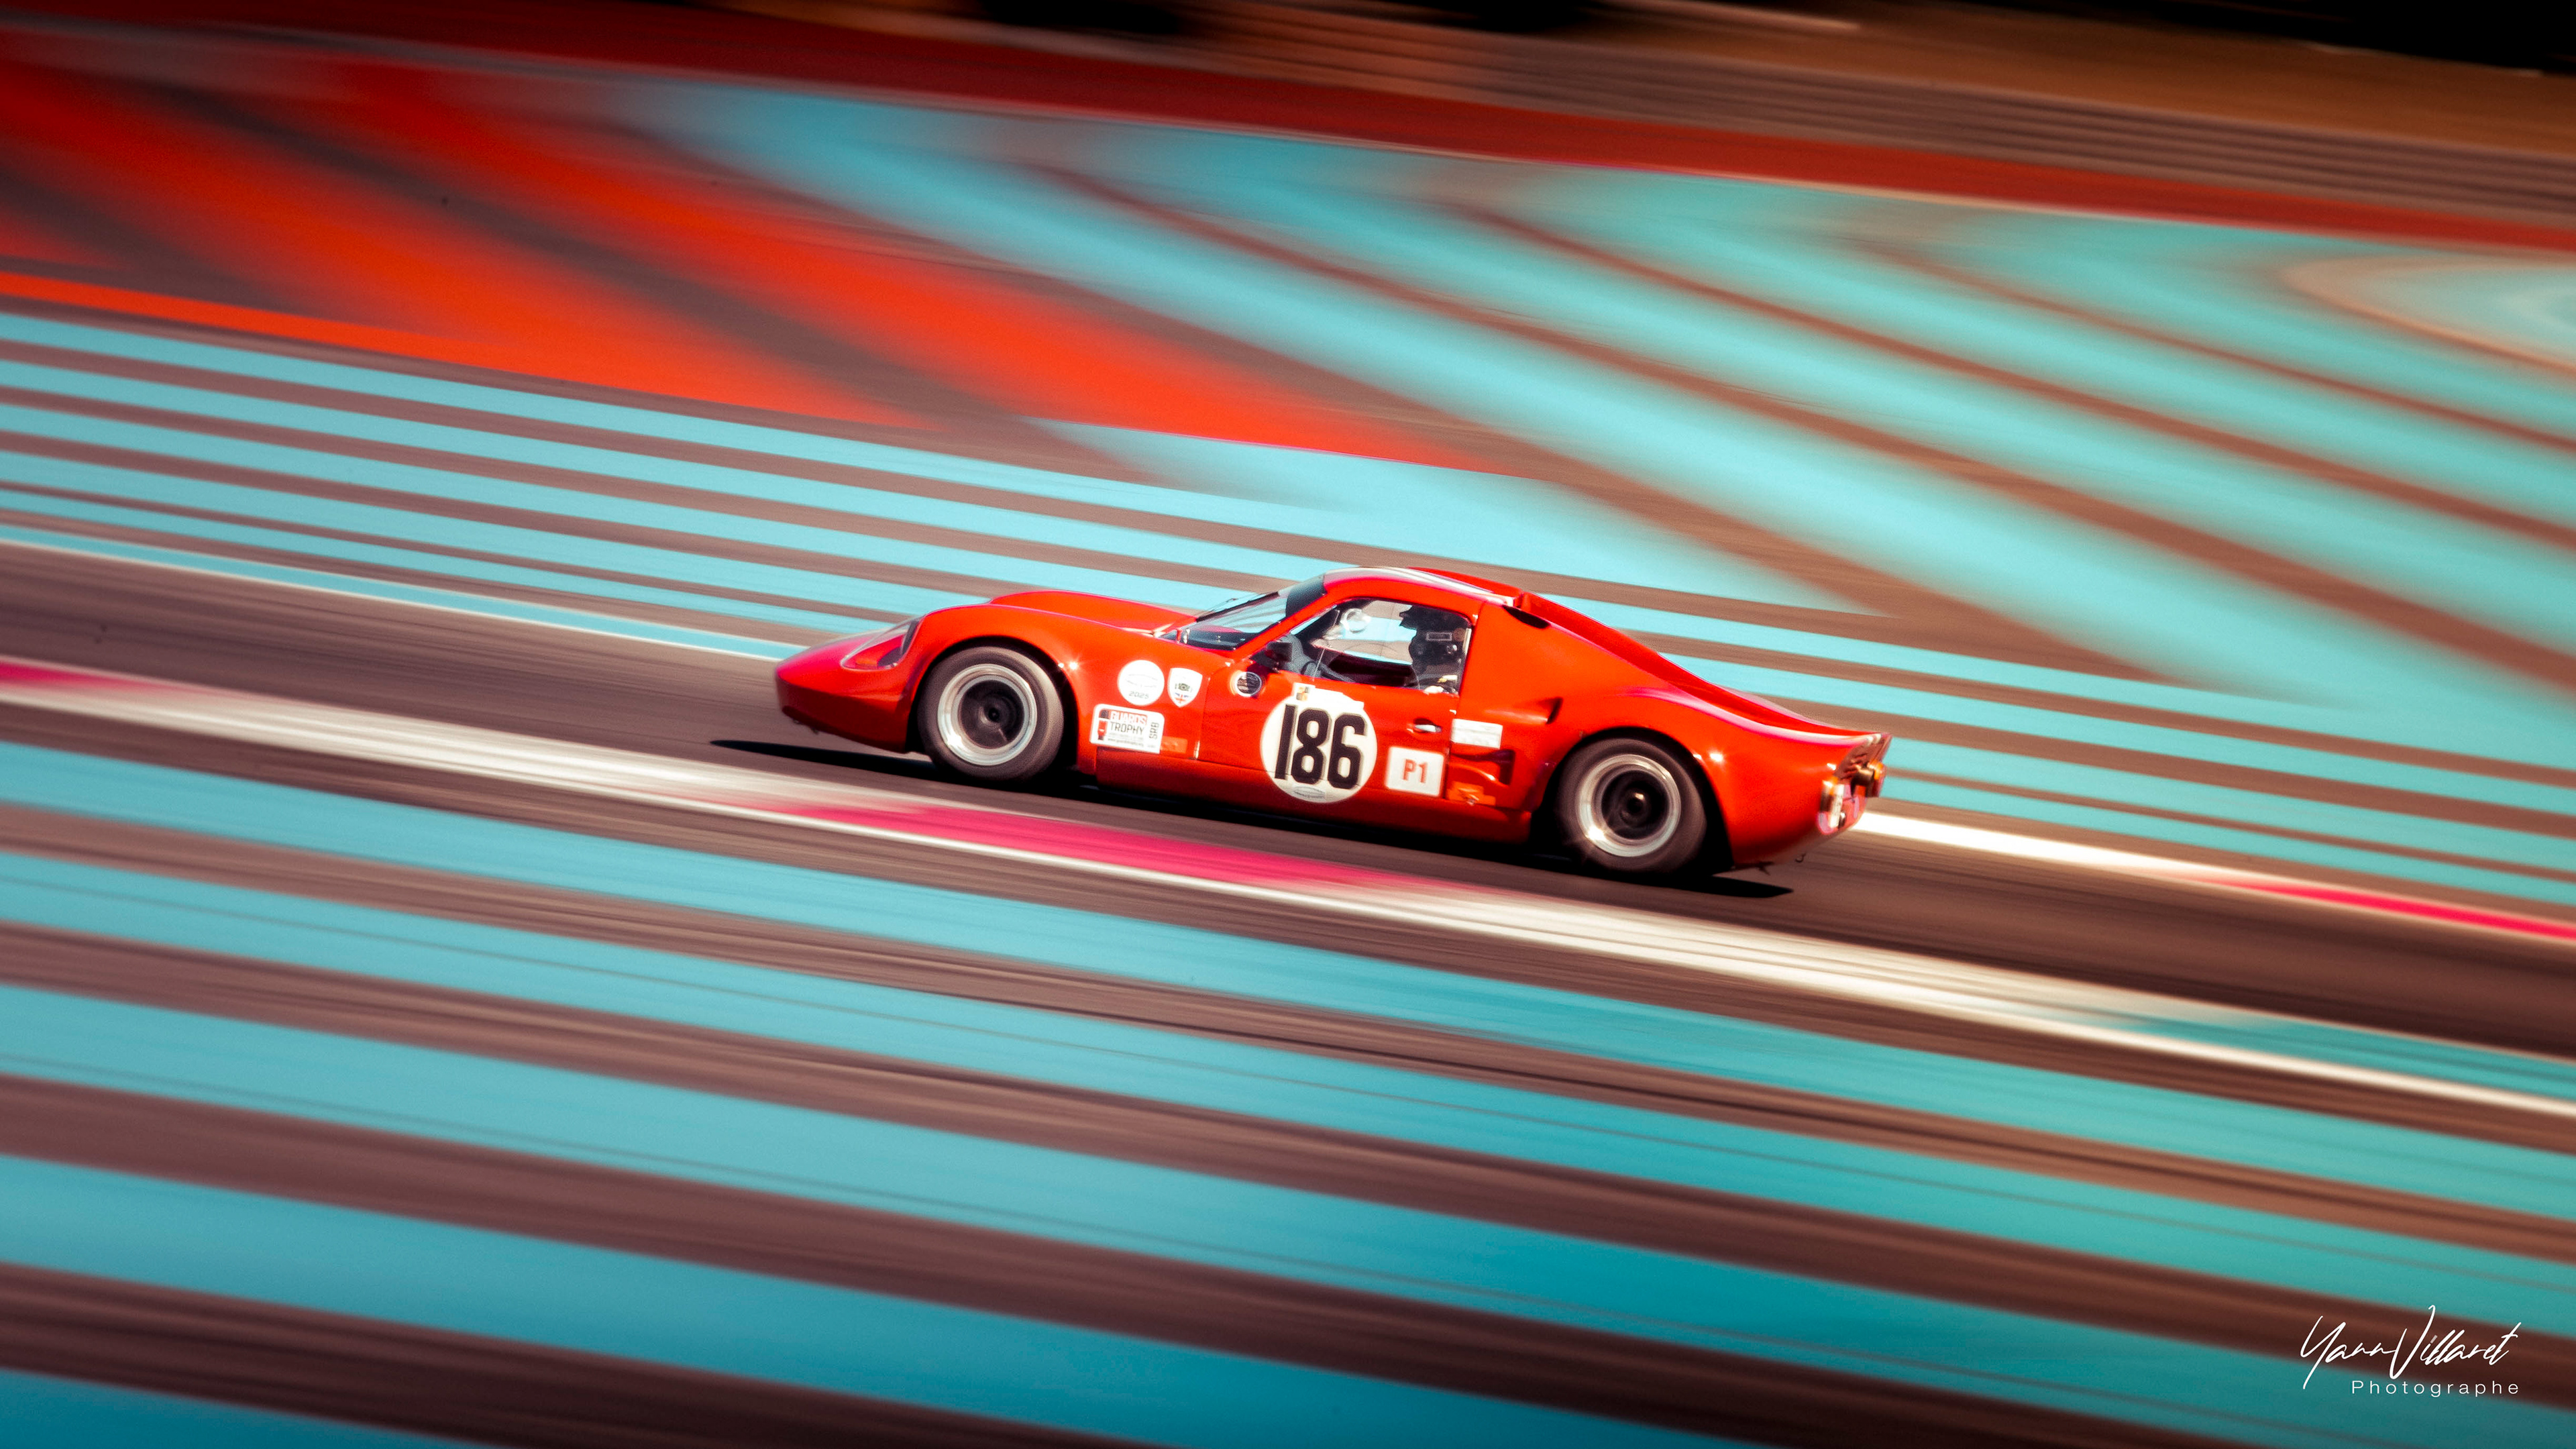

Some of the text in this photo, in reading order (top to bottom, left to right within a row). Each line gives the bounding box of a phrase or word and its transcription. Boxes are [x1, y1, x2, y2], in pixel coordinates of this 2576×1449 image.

[1128, 690, 1149, 699] 2025
[1110, 710, 1147, 725] GUARDS
[1110, 721, 1144, 735] TROPHY
[1274, 704, 1367, 790] 186
[1403, 759, 1427, 784] P1
